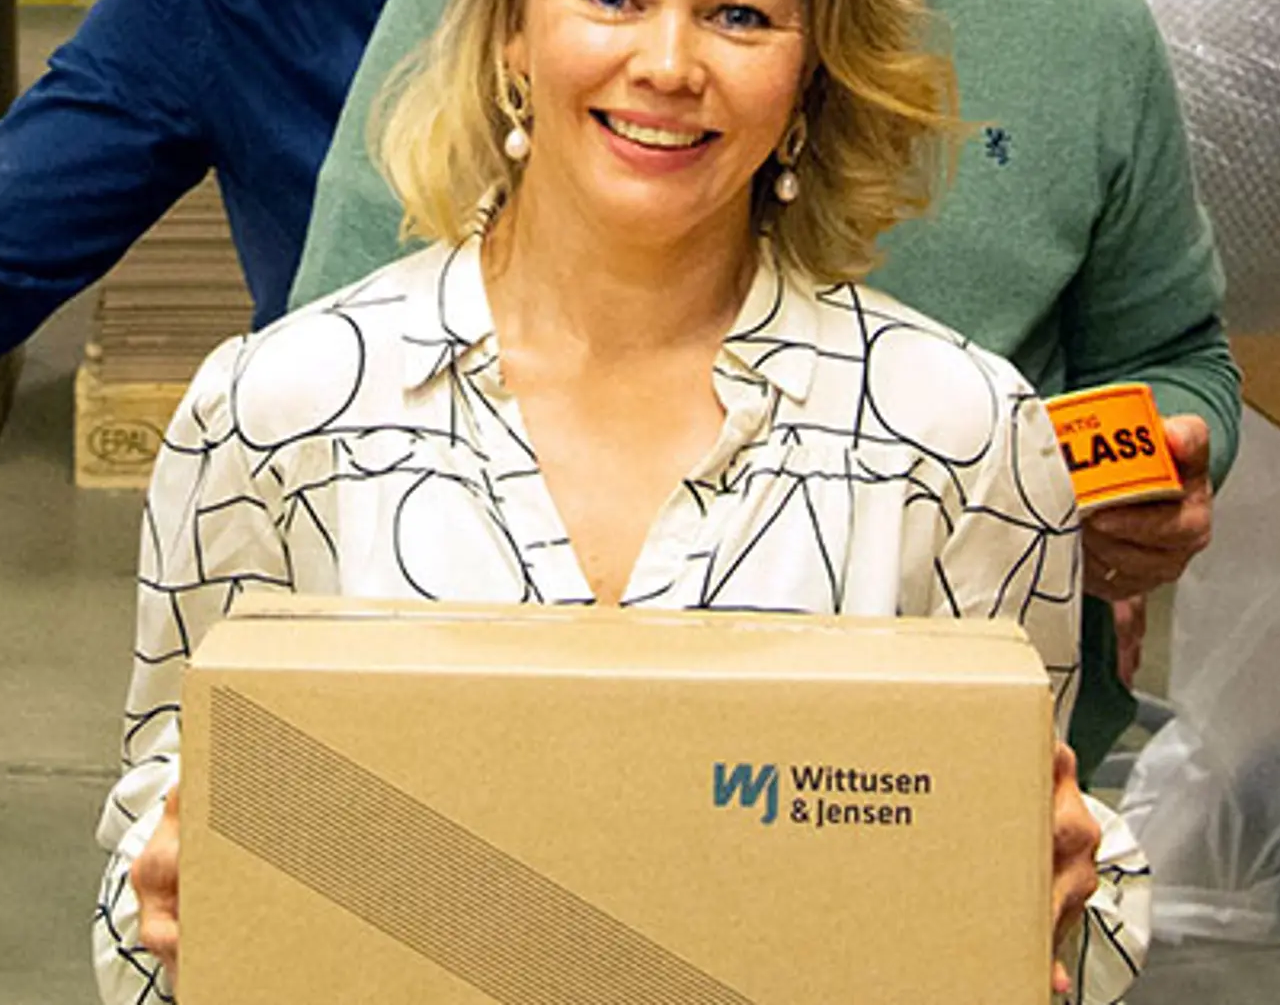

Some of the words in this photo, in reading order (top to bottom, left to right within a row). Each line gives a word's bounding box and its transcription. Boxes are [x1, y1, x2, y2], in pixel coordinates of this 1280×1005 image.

[790, 765, 931, 794] Wittusen
[790, 797, 809, 824] &
[815, 798, 912, 828] Jensen
